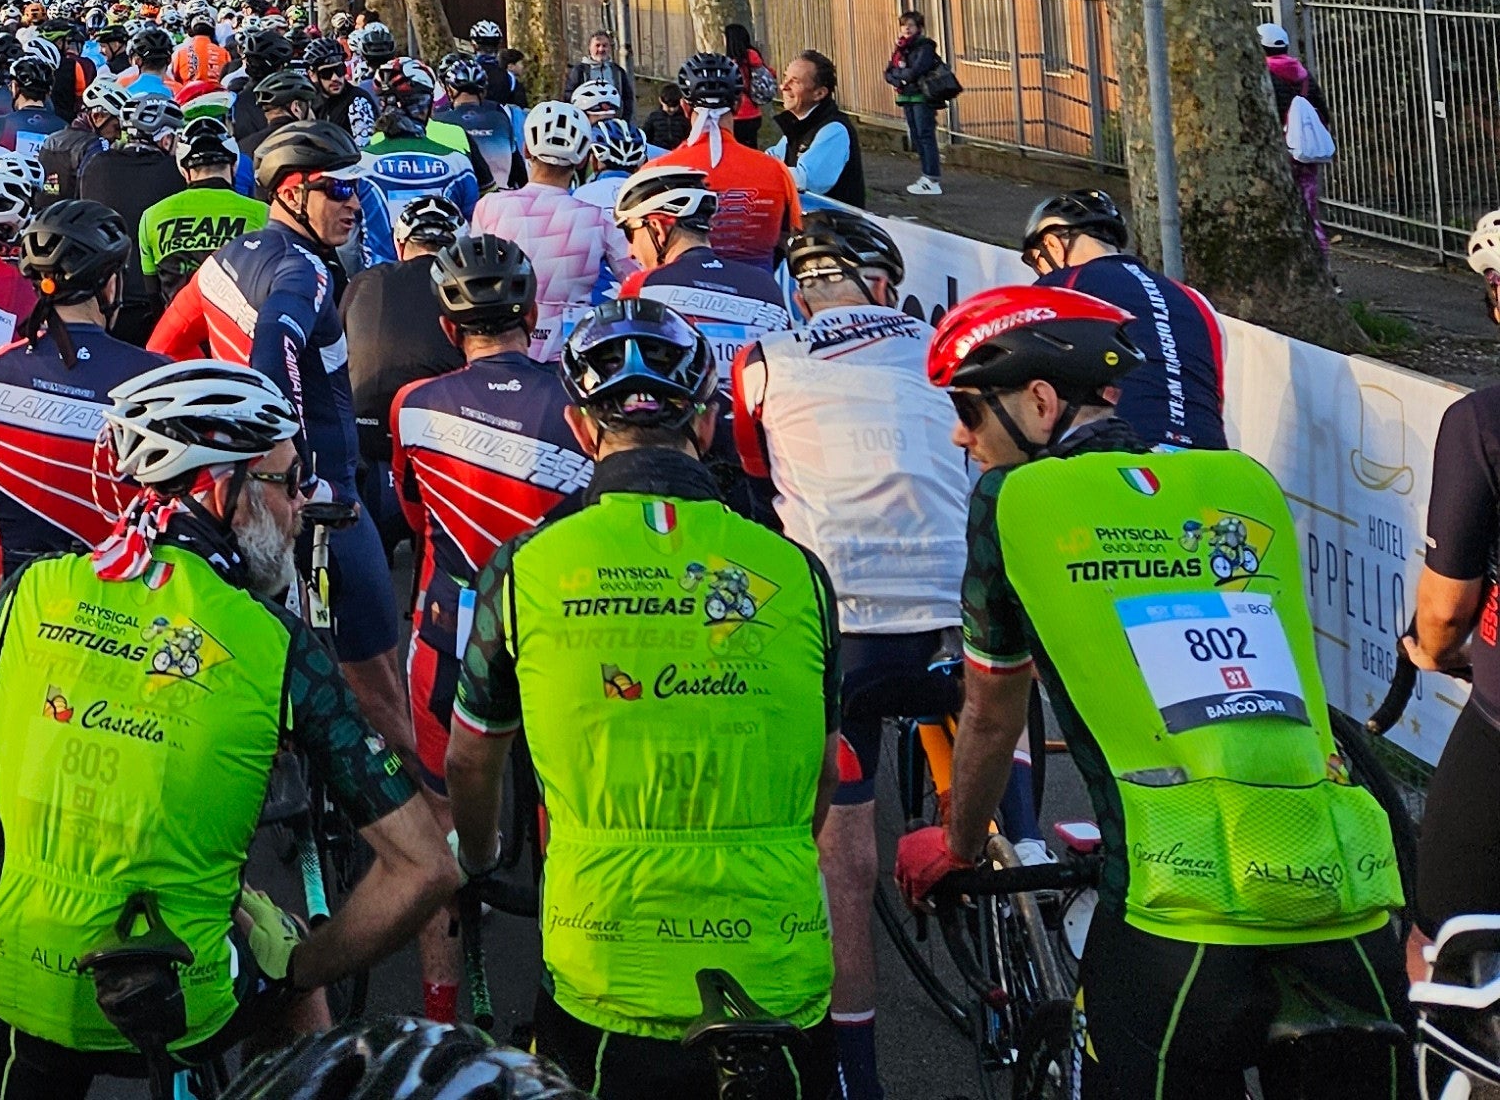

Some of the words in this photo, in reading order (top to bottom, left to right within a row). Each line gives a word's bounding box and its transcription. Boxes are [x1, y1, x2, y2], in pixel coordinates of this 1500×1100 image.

[376, 159, 446, 175] ITALIA
[157, 216, 247, 245] TEAM
[159, 236, 235, 256] VISCARD
[1094, 527, 1173, 542] PHYSICAL
[1368, 514, 1407, 562] HOTEL
[1102, 542, 1167, 555] evolution
[598, 566, 674, 580] PHYSICAL
[1066, 557, 1203, 583] TORTUGAS
[600, 580, 665, 592] evolution
[1307, 531, 1407, 640] PPELLO
[77, 601, 140, 628] PHYSICAL
[562, 597, 697, 618] TORTUGAS
[1248, 603, 1274, 616] BGY
[74, 614, 127, 636] evolution
[37, 622, 149, 662] TORTUGAS
[1184, 627, 1257, 663] 802
[654, 663, 748, 699] Castello
[1226, 670, 1245, 685] 3T
[1361, 638, 1423, 701] BERGO
[81, 700, 164, 743] Castello
[1205, 700, 1257, 719] BANCO
[1258, 698, 1286, 713] BPM
[61, 736, 119, 787] 803
[1132, 842, 1217, 870] Gentlemen
[1245, 860, 1281, 879] AL
[1286, 863, 1344, 886] LAGO
[547, 901, 622, 936] Gentlemen
[656, 918, 684, 938] AL
[689, 918, 752, 939] LAGO
[30, 946, 52, 969] AL
